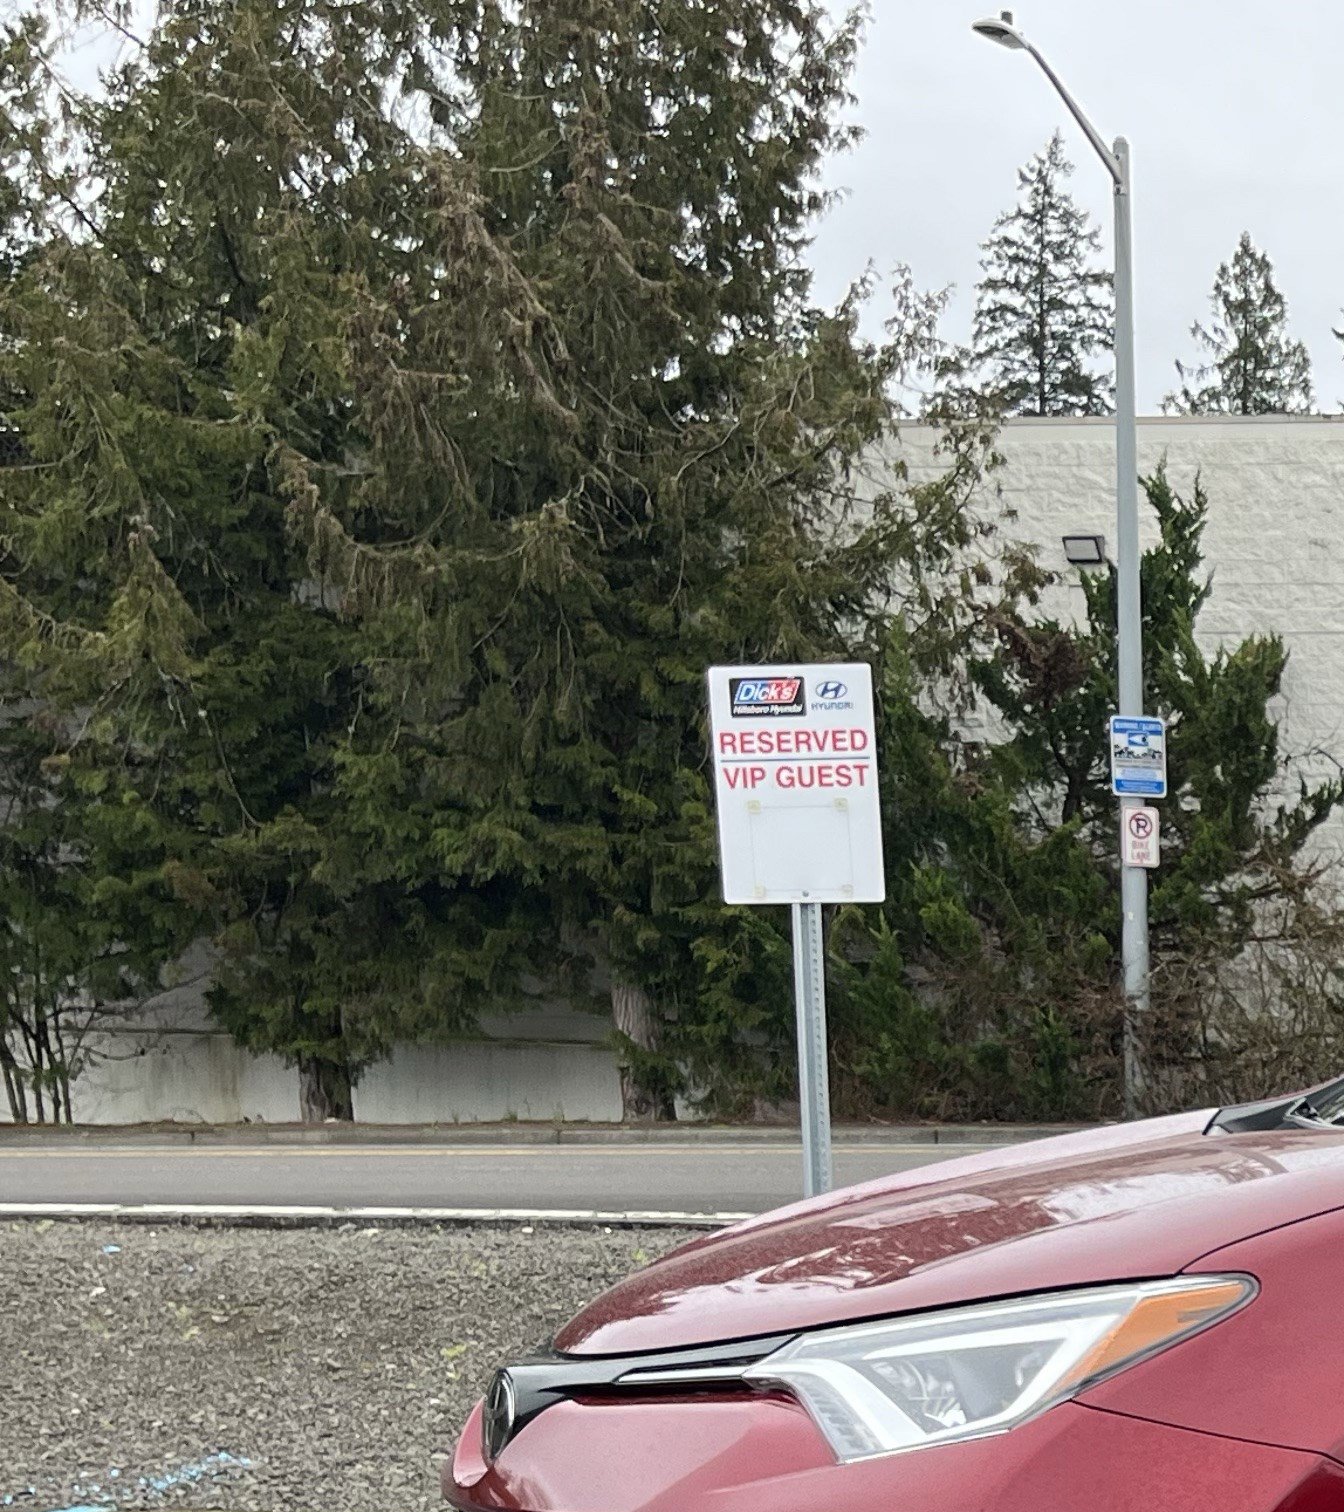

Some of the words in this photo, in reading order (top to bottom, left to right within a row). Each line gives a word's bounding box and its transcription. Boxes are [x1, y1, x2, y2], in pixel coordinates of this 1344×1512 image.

[811, 702, 854, 711] HYUNDAI
[719, 729, 869, 755] RESERVED
[722, 766, 767, 790] VIP
[775, 764, 870, 789] GUEST
